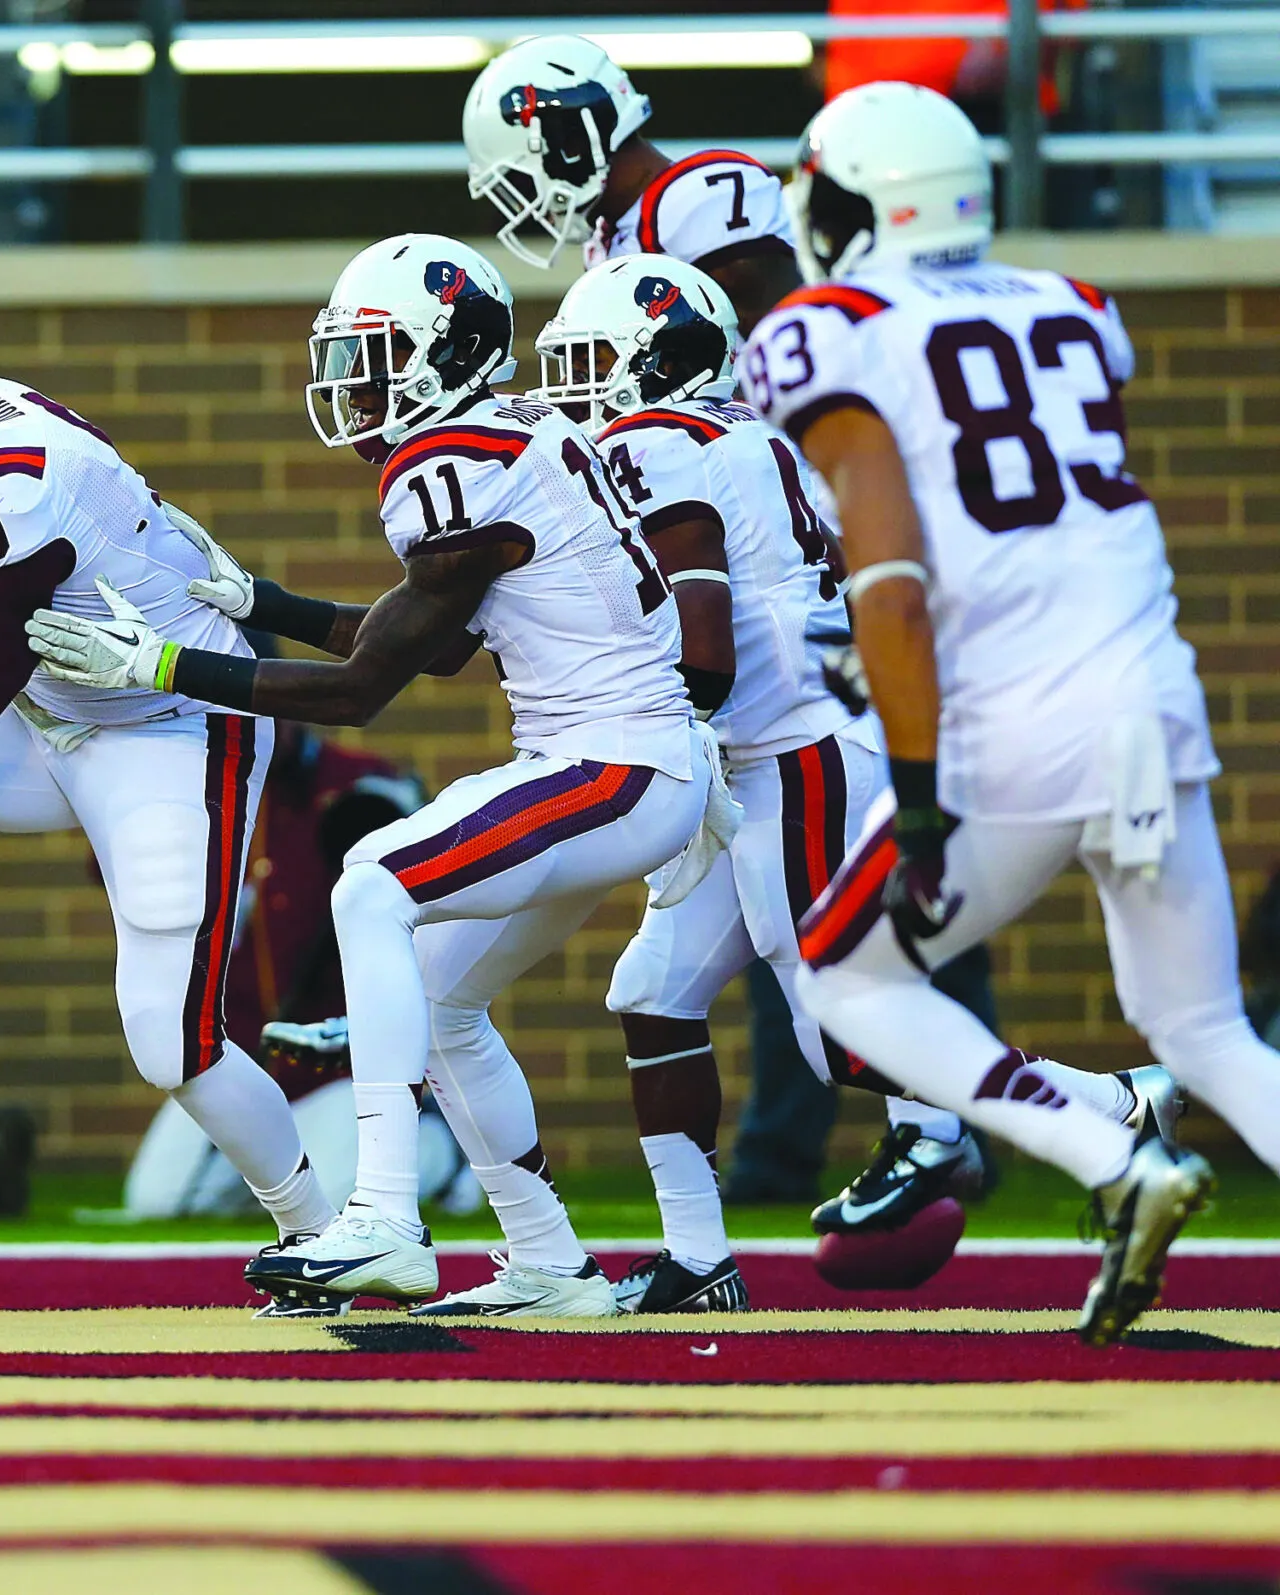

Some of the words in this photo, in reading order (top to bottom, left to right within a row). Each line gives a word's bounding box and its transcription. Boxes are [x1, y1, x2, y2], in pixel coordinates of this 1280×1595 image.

[704, 170, 751, 232] 7
[747, 319, 815, 415] 83
[925, 315, 1151, 534] 83
[407, 461, 472, 538] 11
[608, 442, 654, 505] 4
